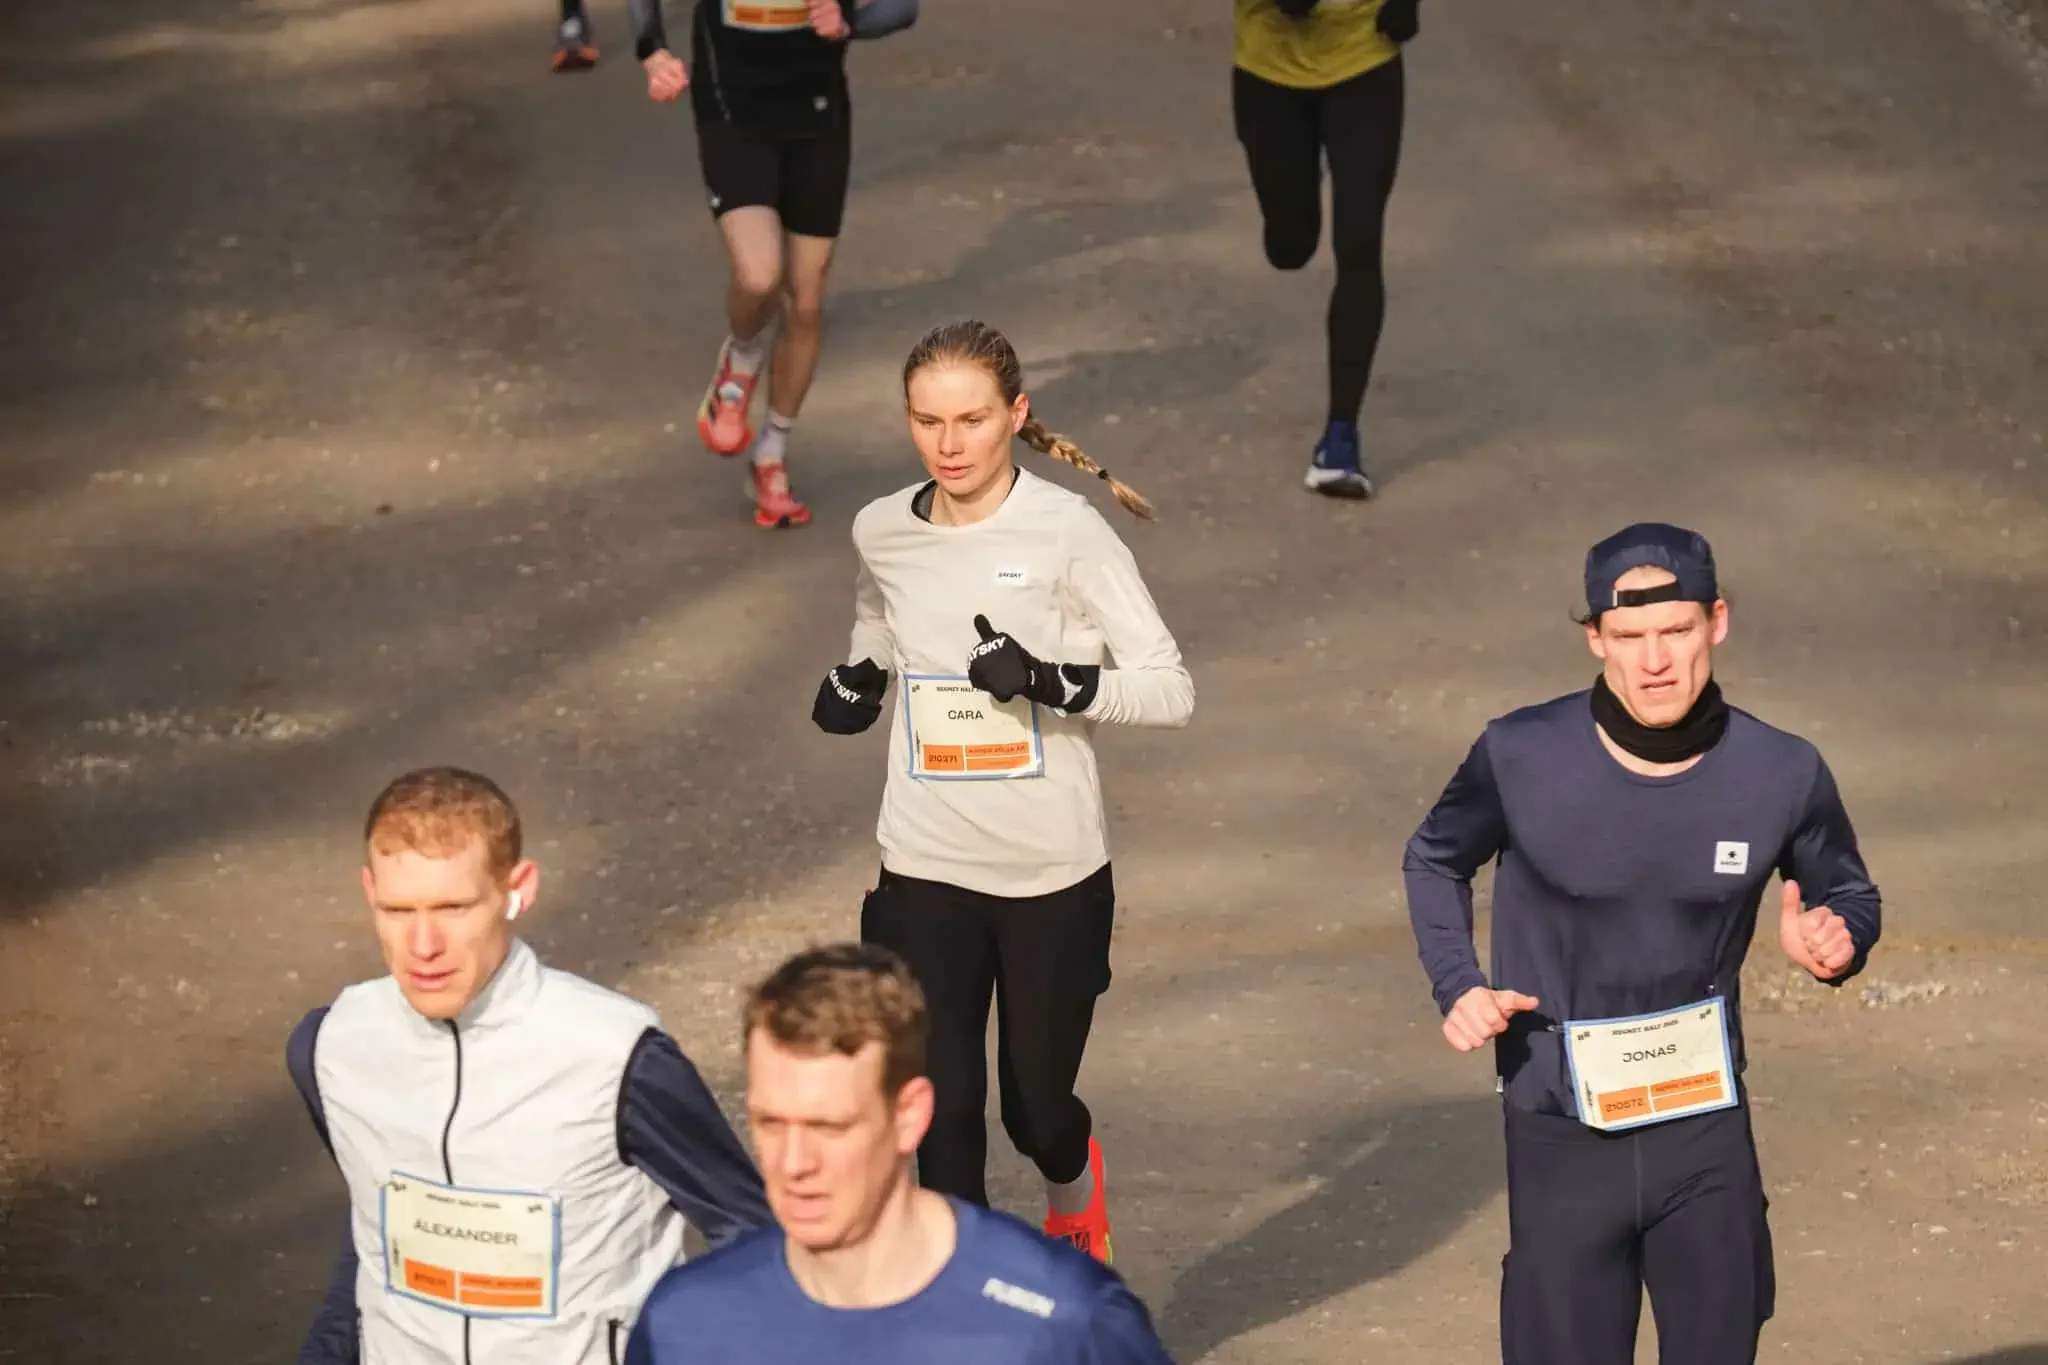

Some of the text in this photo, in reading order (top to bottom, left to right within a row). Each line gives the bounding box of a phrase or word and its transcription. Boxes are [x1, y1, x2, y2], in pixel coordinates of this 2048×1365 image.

[947, 709, 984, 721] CARA
[1622, 1043, 1677, 1063] JONAS
[413, 1218, 518, 1246] ALEXANDER
